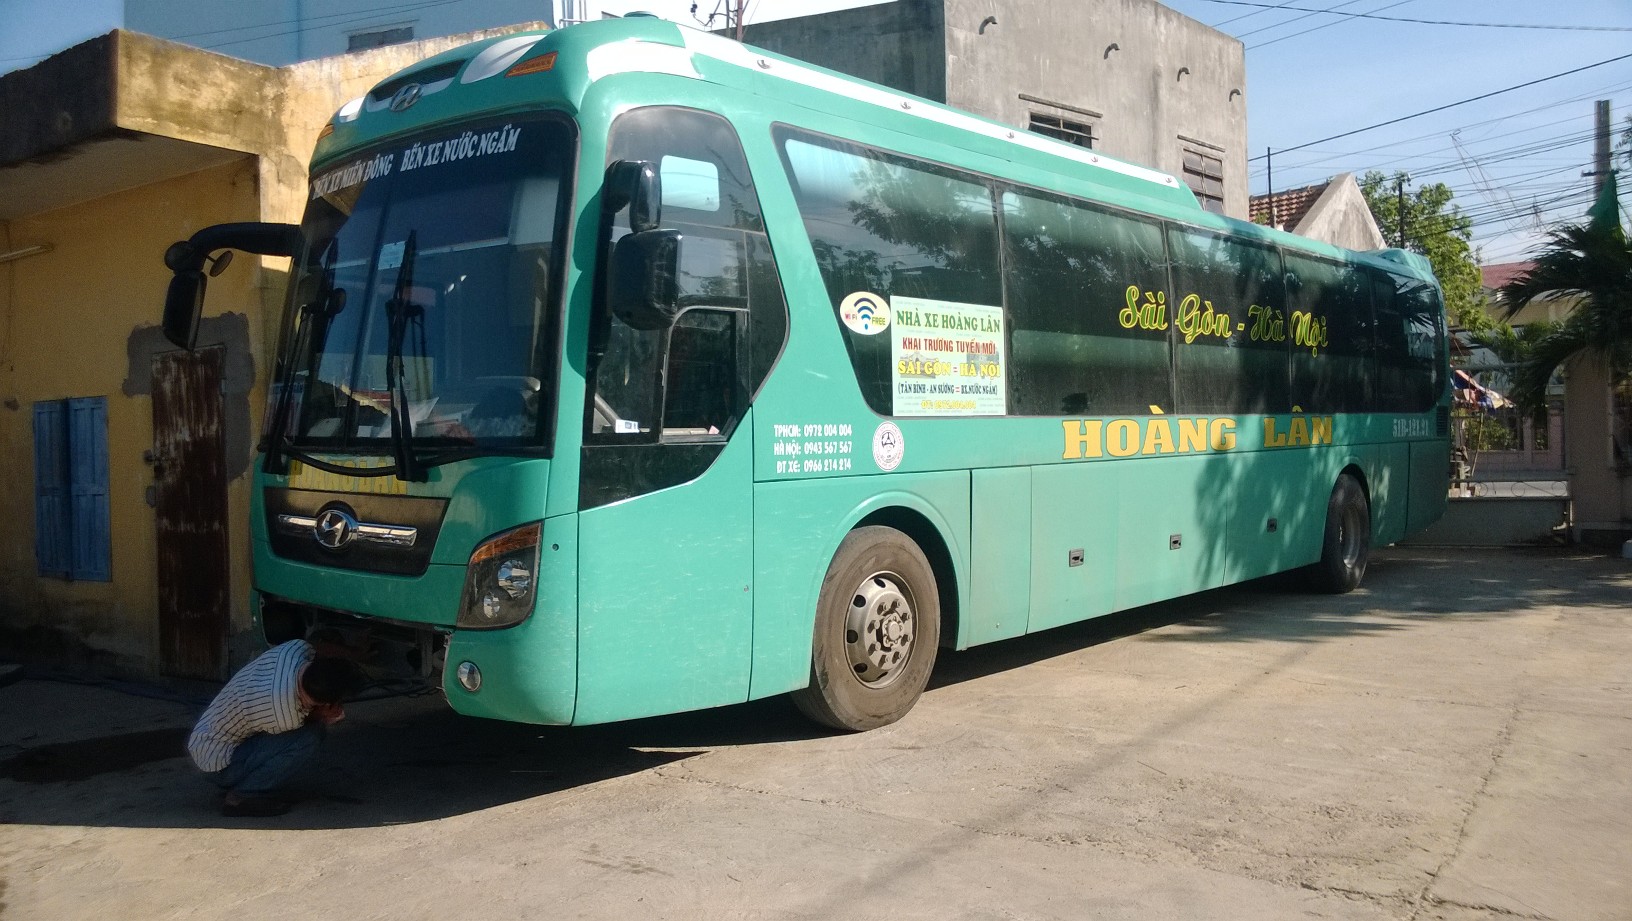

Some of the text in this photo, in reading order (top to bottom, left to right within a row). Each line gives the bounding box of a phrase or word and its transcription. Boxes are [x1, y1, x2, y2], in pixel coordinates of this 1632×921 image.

[400, 142, 427, 172] BẾN
[424, 142, 443, 167] XE
[441, 131, 479, 163] NƯỚC
[872, 316, 886, 326] FREE
[896, 307, 1001, 333] NHÀ XE HOÀNG LÂN
[1118, 285, 1169, 331] Sài
[1175, 293, 1233, 345] Gòn
[1248, 305, 1286, 343] Hà
[1290, 310, 1329, 358] Nội
[902, 337, 922, 350] KHAI
[959, 359, 977, 377] HÀ
[774, 424, 852, 438] TPHCM: 0972 004 004
[1062, 405, 1333, 459] HOÀNG LÂN
[774, 440, 852, 458] HÀ NỘI: 0943 567 567
[776, 460, 786, 473] ĐT
[804, 459, 822, 472] 0966
[824, 458, 837, 471] 214
[839, 458, 851, 471] 214
